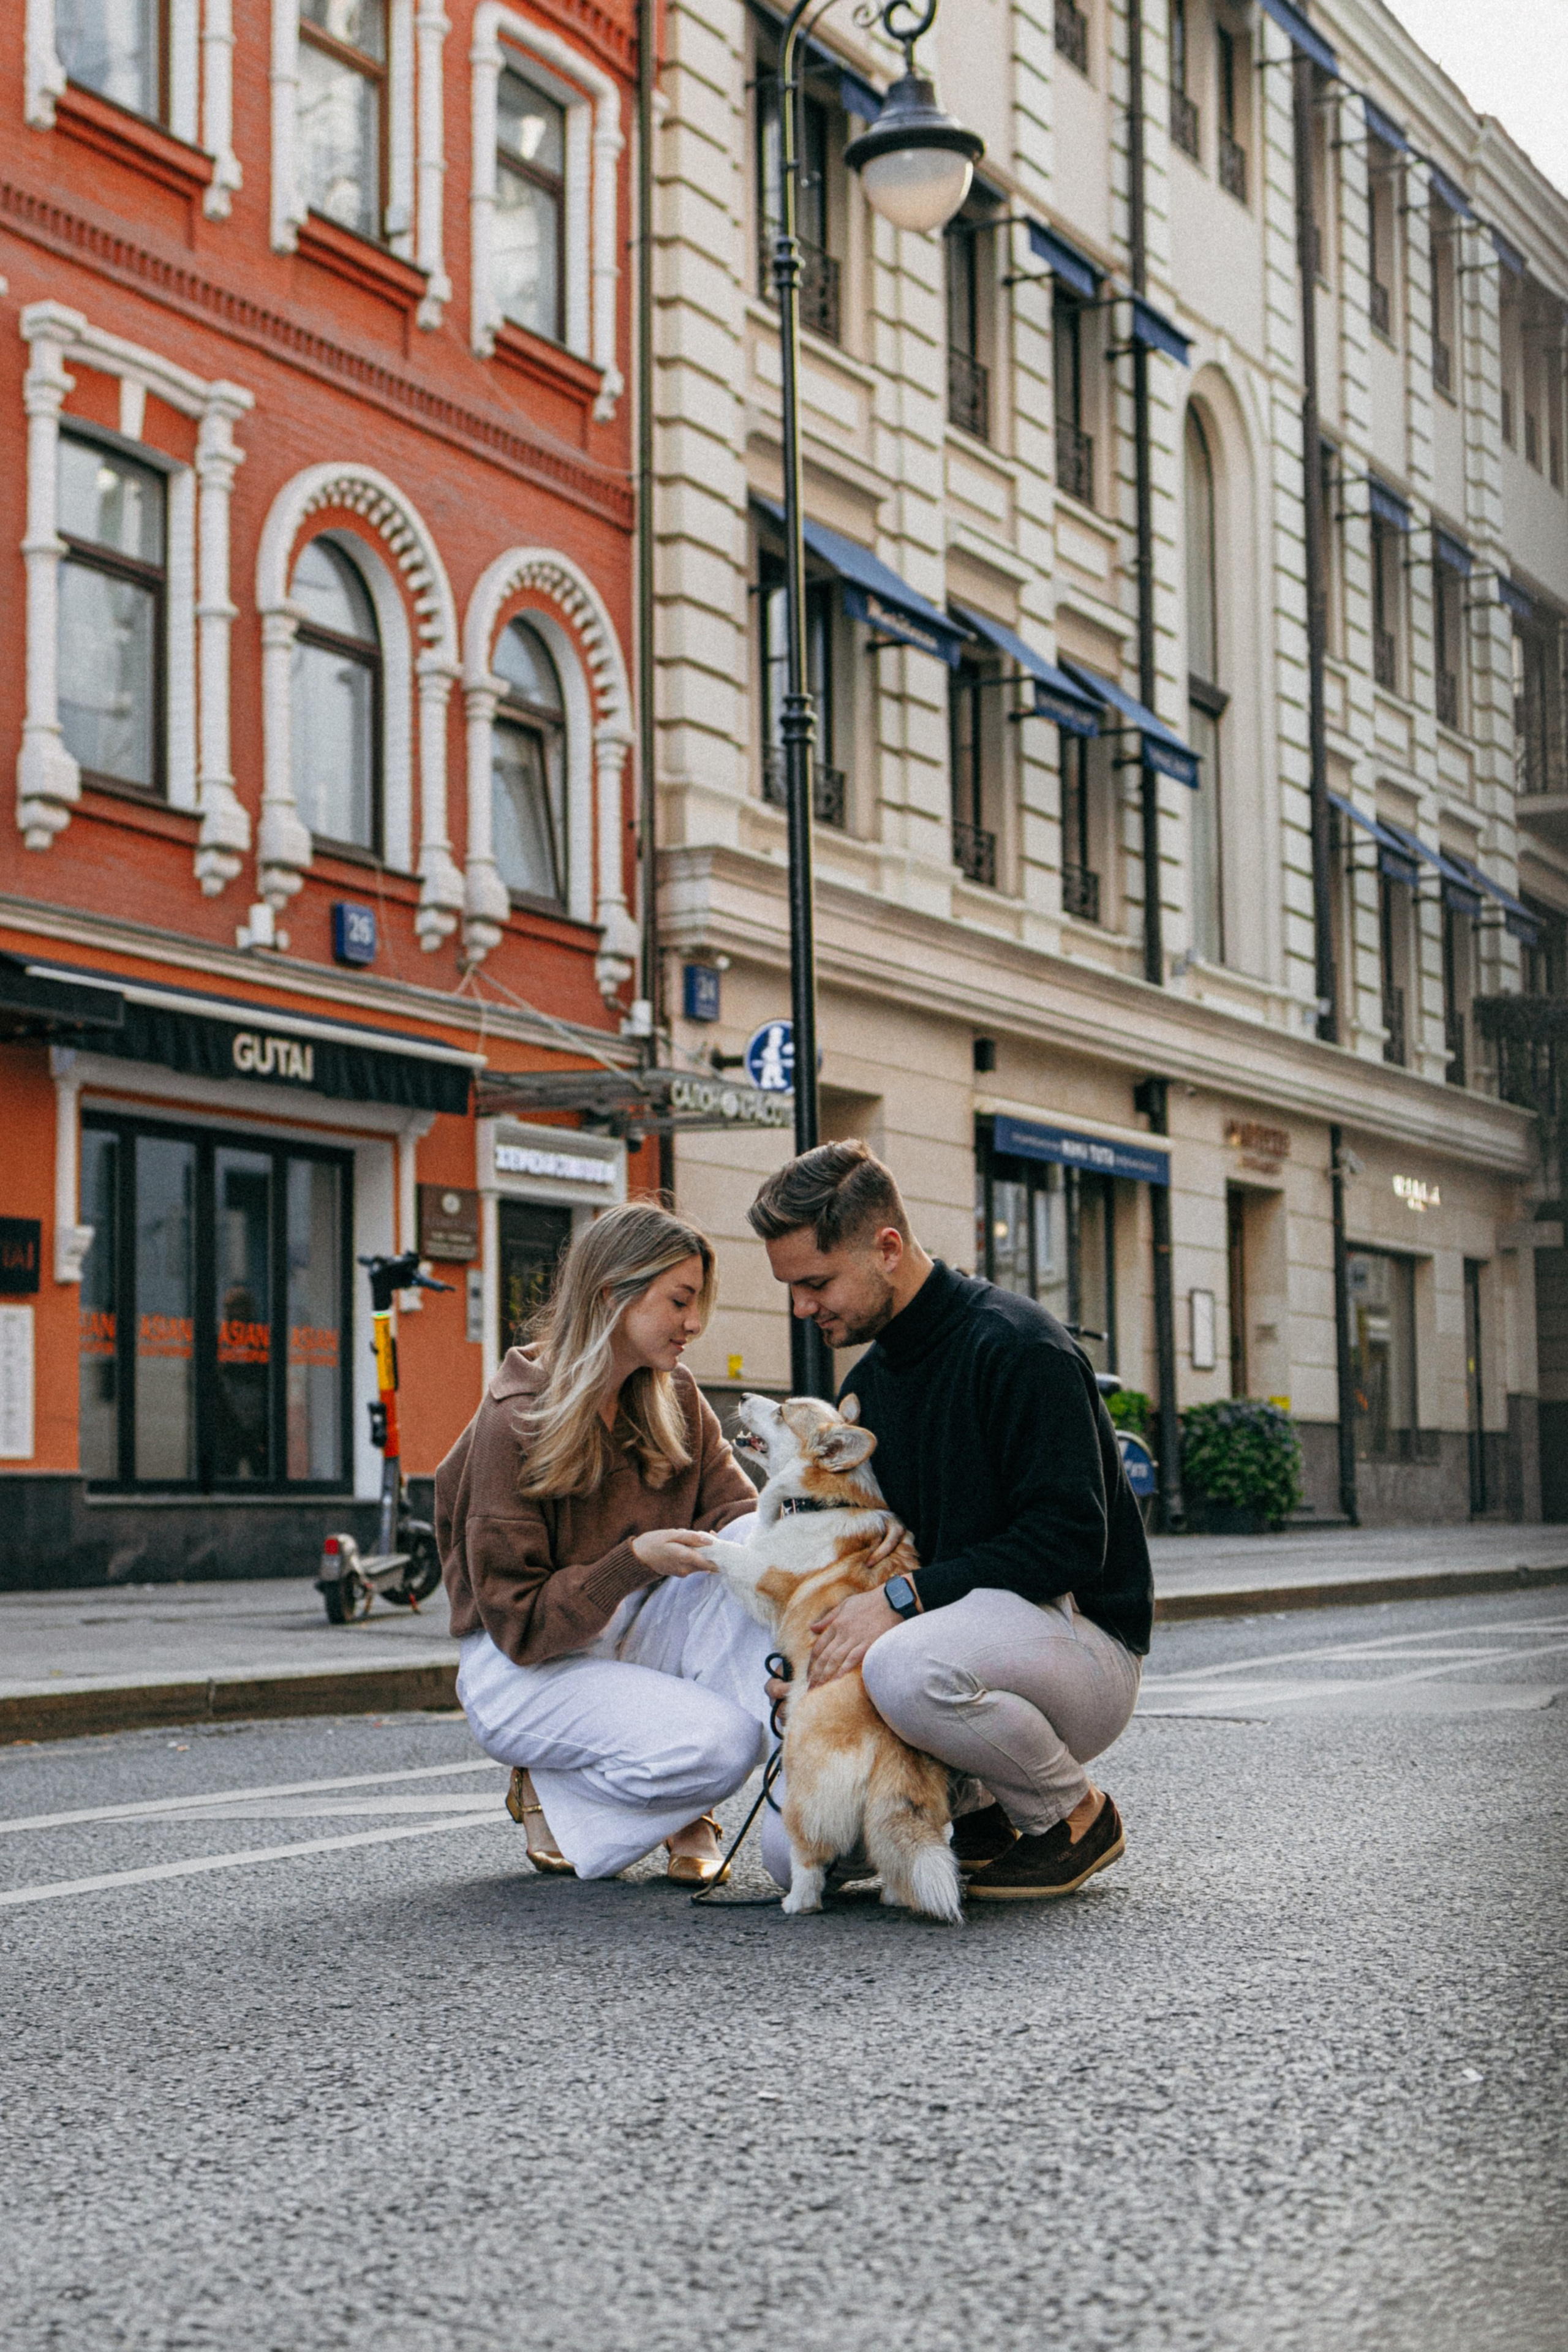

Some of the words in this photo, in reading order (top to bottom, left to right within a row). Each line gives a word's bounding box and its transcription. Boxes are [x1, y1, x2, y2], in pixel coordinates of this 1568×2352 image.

[348, 912, 372, 944] 26
[233, 1033, 314, 1082] GUTAI
[217, 1319, 270, 1347] ASIAN
